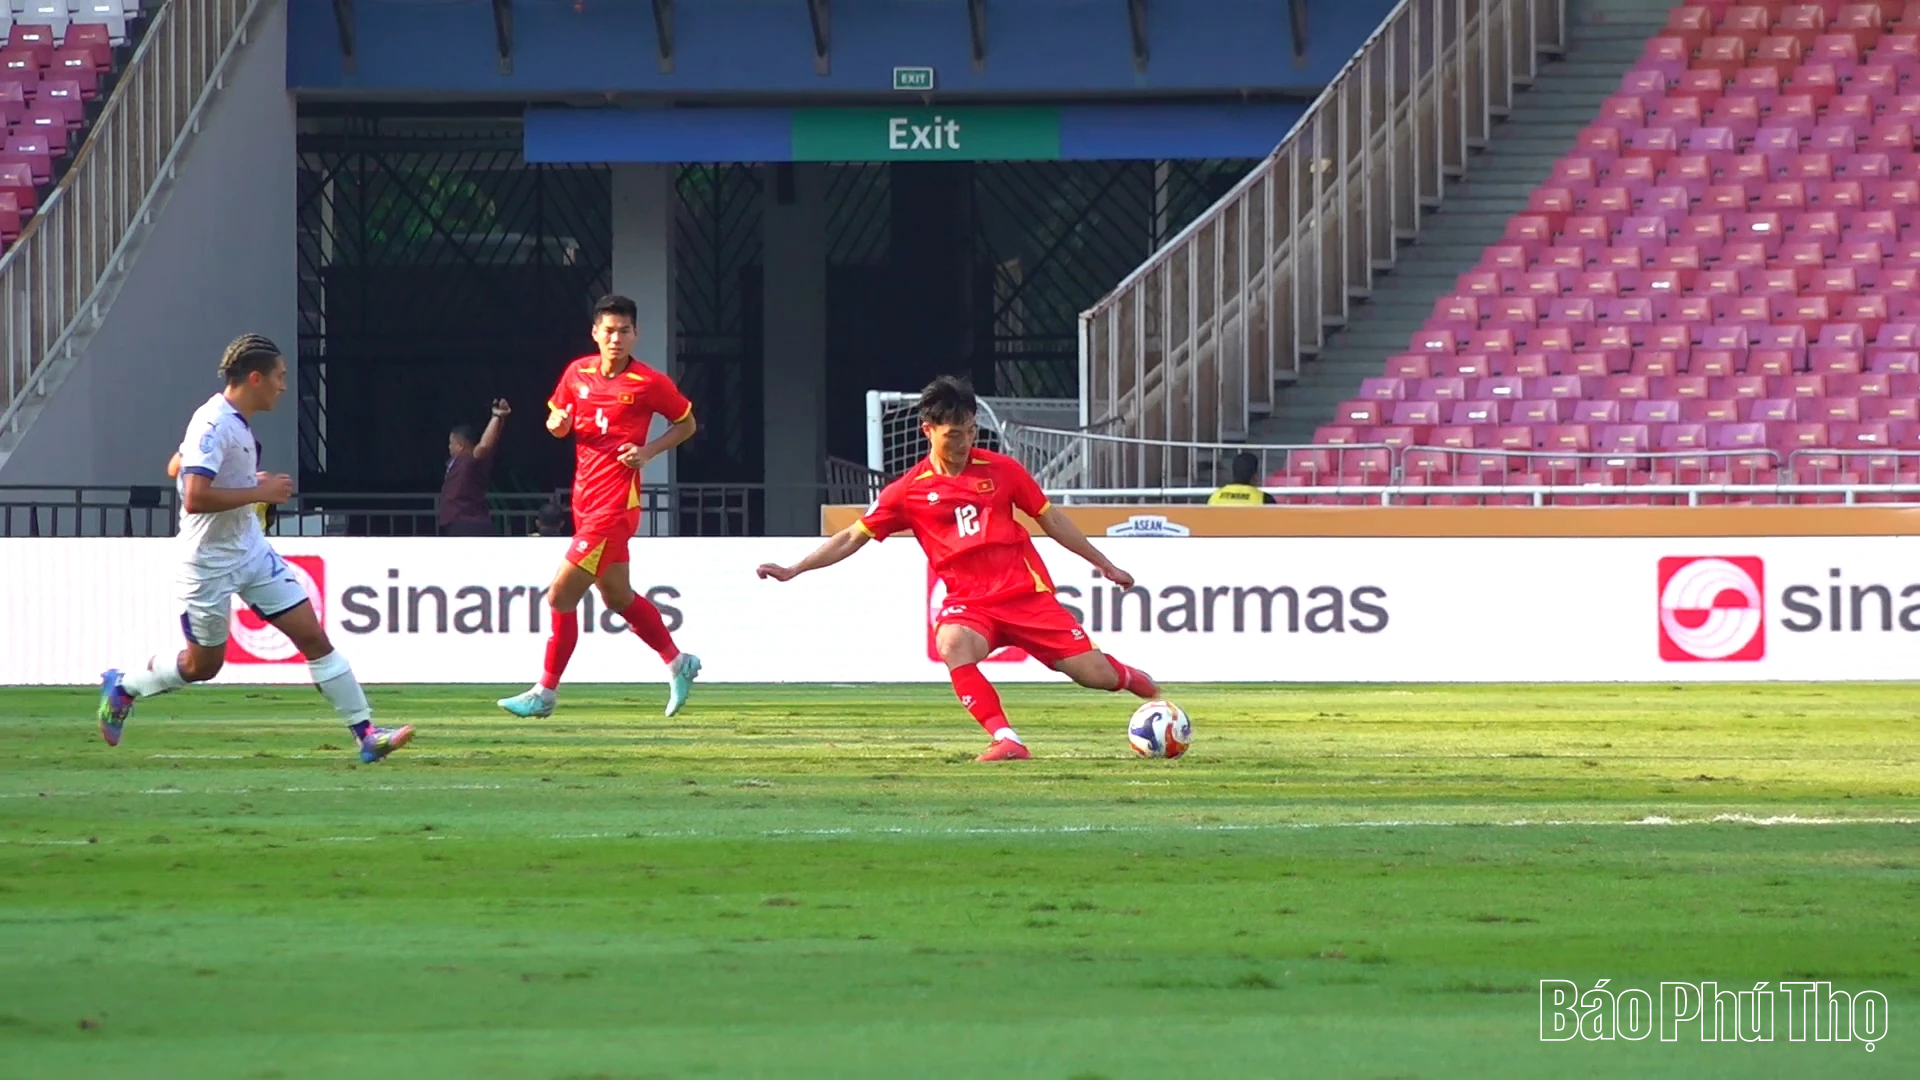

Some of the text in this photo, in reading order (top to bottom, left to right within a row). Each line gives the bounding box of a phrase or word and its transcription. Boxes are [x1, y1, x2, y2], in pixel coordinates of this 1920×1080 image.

[901, 73, 927, 84] EXIT
[889, 115, 960, 149] Exit
[595, 407, 609, 435] 4
[954, 504, 980, 538] 12
[1133, 520, 1163, 531] ASEAN
